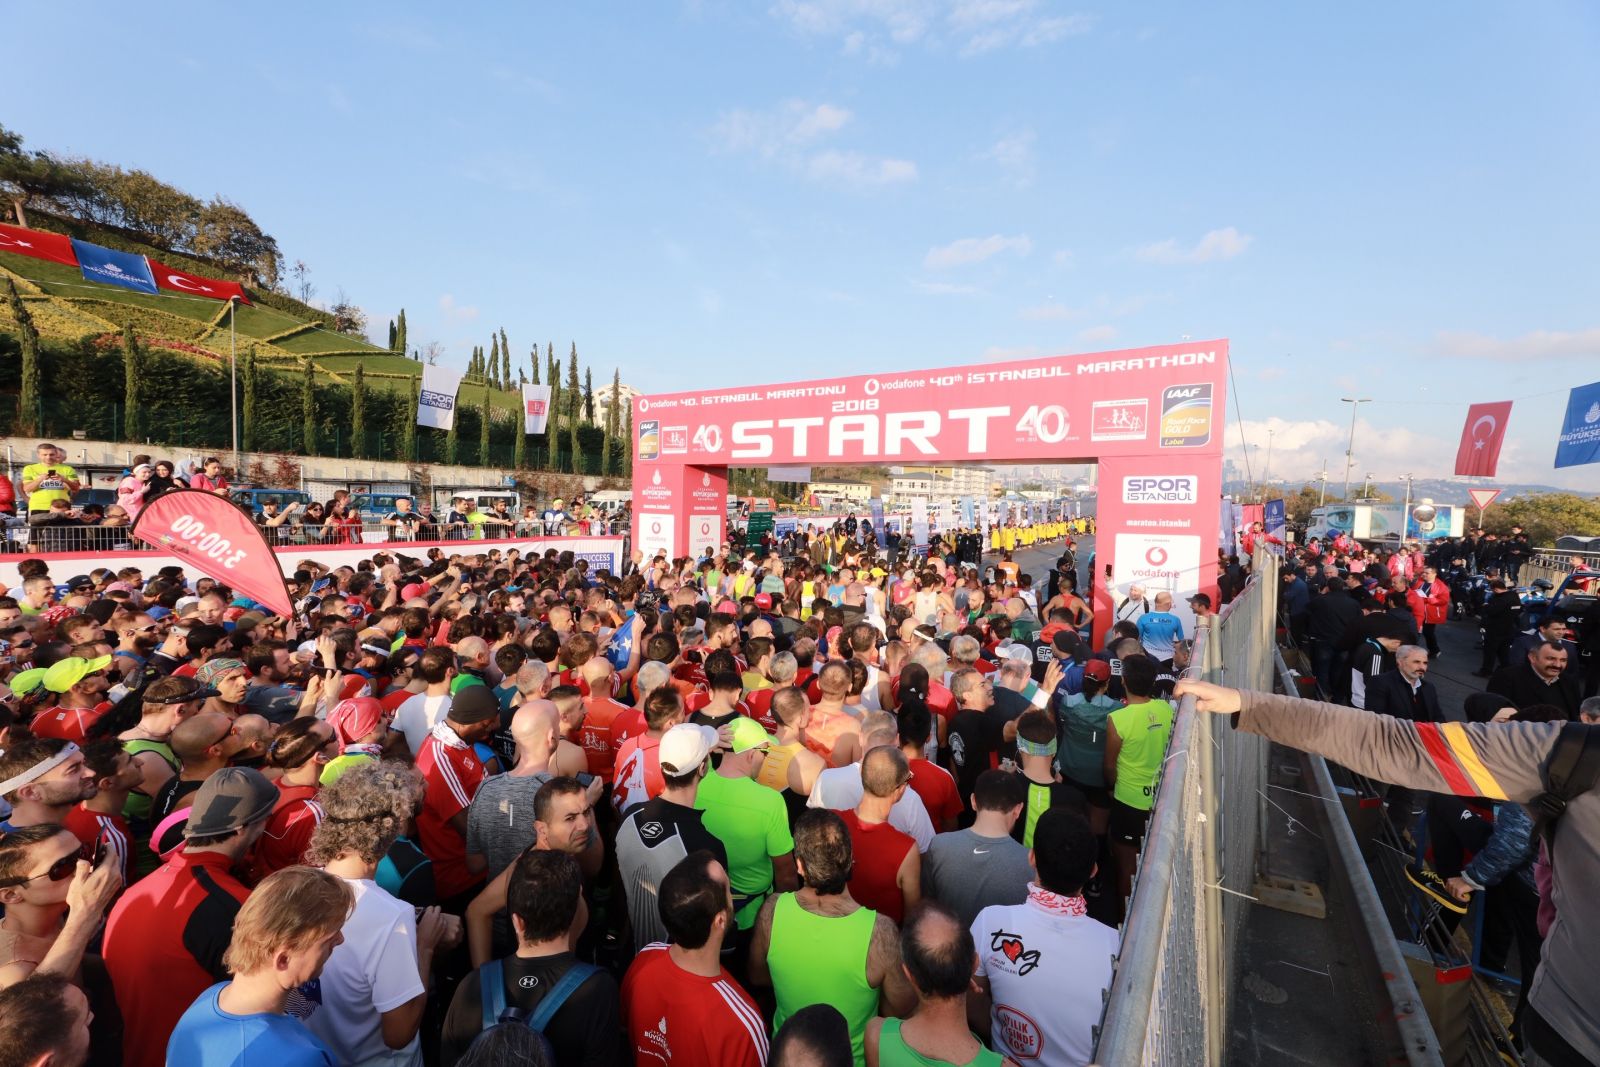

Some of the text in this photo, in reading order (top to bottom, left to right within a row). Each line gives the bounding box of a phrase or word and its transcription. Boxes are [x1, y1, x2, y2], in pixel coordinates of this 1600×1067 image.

[881, 378, 925, 390] vodafone
[1076, 351, 1216, 375] MARATHON
[422, 391, 453, 404] SPOR
[649, 399, 678, 409] vodafone
[766, 384, 846, 399] MARATONU
[1166, 387, 1202, 399] IAAF
[831, 398, 880, 412] 2018
[1015, 404, 1070, 443] 40
[1164, 424, 1190, 435] GOLD
[692, 424, 723, 453] 40
[731, 405, 1011, 459] START
[1164, 438, 1185, 447] Label
[1127, 478, 1191, 492] SPOR
[1126, 519, 1191, 528] maraton.istanbul
[582, 554, 611, 562] SUCCESS
[589, 562, 611, 570] HLETES
[1132, 568, 1180, 579] vodafone
